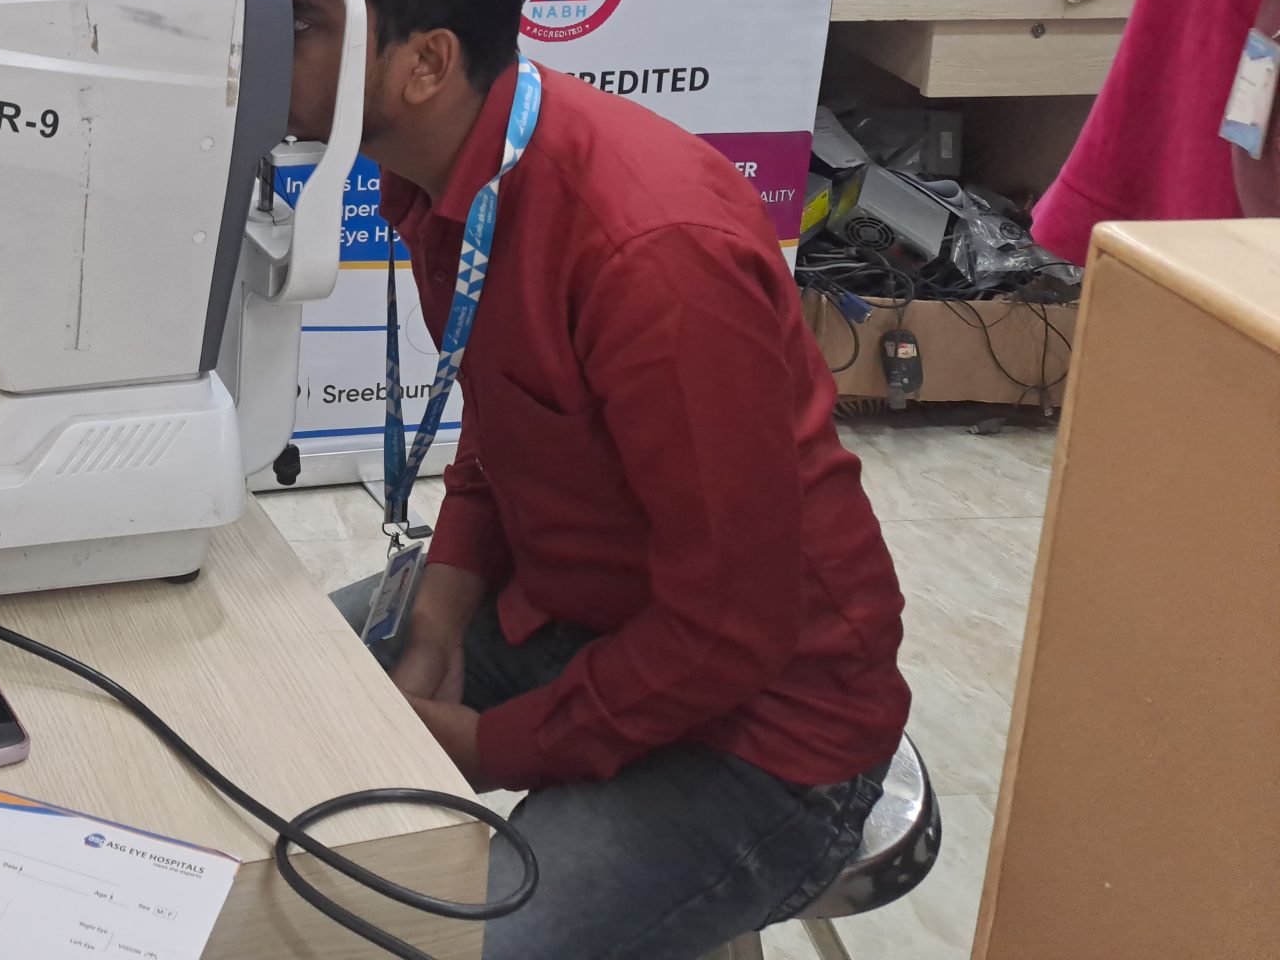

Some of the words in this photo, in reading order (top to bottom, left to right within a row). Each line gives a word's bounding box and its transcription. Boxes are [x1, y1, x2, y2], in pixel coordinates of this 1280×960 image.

[532, 5, 587, 19] NABH
[531, 26, 583, 39] ACCREDITED
[342, 204, 378, 221] per
[106, 842, 126, 852] ASG
[129, 848, 147, 859] EYE
[149, 854, 205, 874] HOSPITALS
[3, 862, 18, 871] Date
